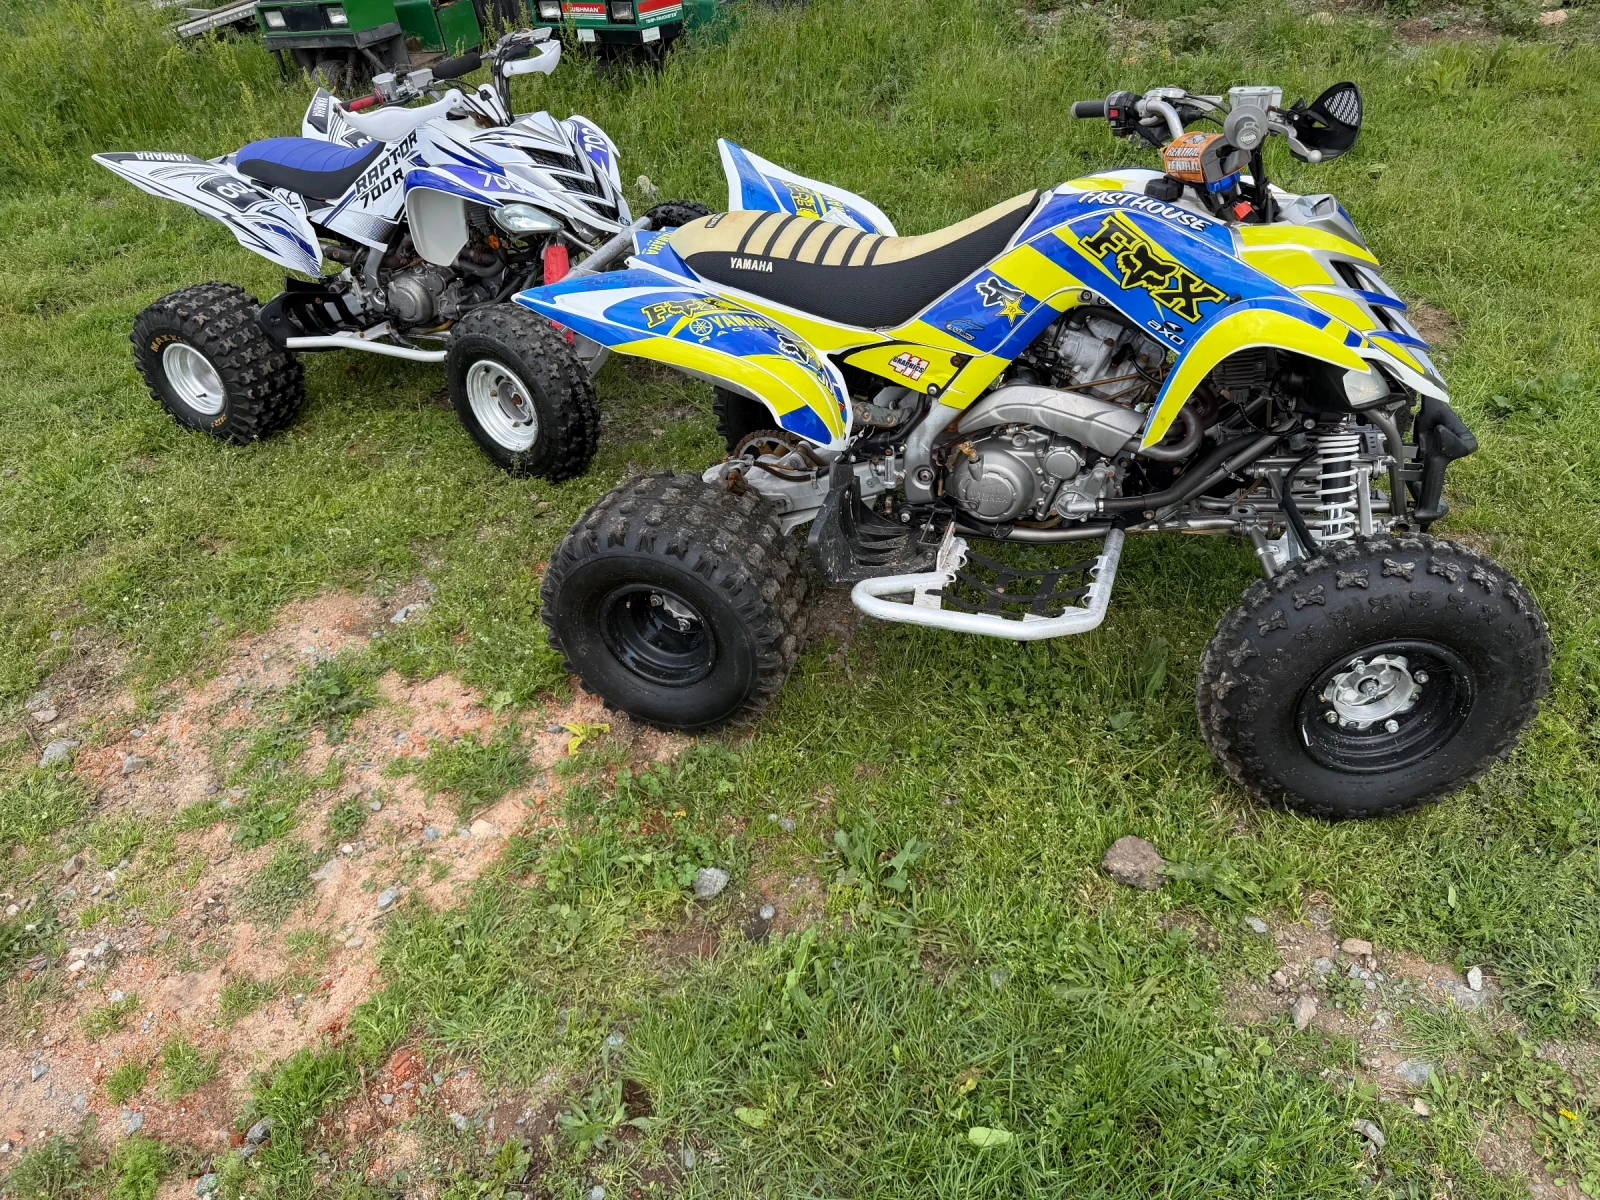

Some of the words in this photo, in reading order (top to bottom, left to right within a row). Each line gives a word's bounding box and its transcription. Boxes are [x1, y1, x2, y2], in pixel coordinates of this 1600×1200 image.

[312, 97, 328, 117] YAMAHA
[134, 152, 192, 162] YAMAHA
[1167, 147, 1200, 157] RENTHAL
[355, 129, 418, 195] RAPTOR
[1168, 160, 1200, 171] RENTHAL
[1079, 191, 1213, 231] FASTHOUSE
[730, 257, 773, 272] YAMAHA
[708, 315, 779, 332] YAMAHA
[892, 356, 925, 374] GRAPHICS
